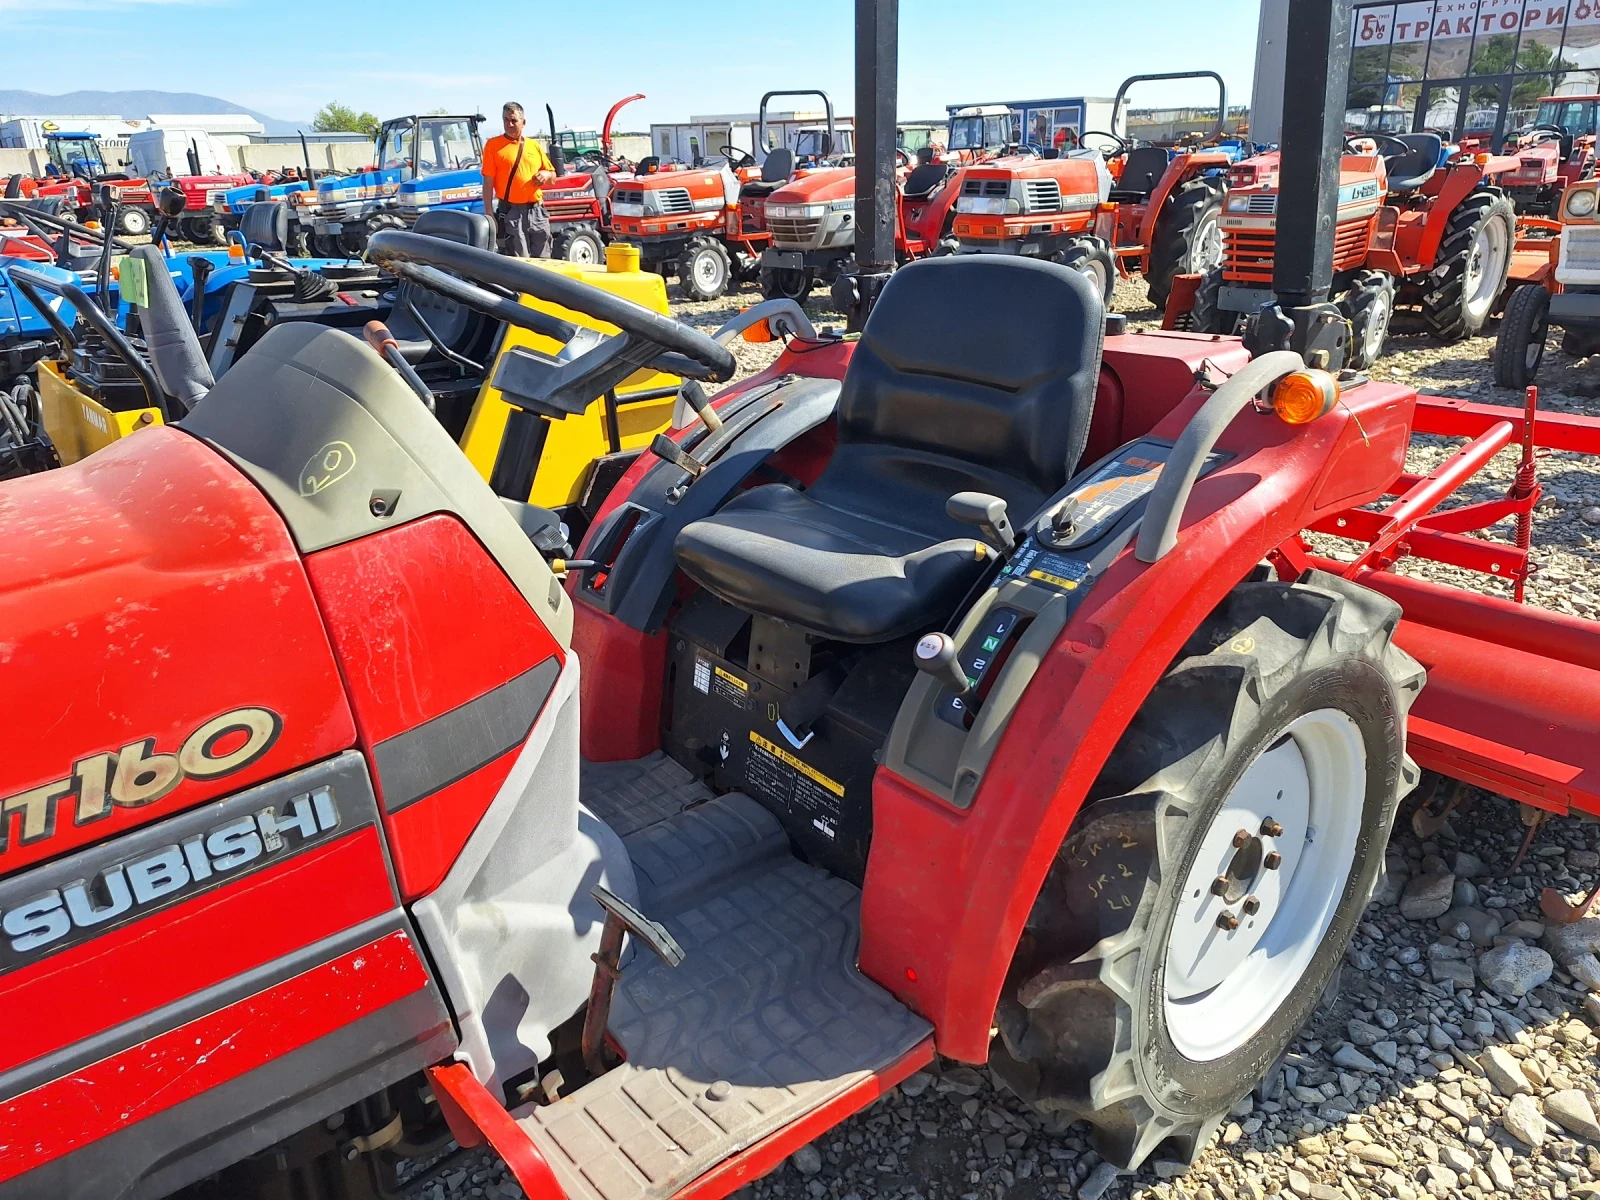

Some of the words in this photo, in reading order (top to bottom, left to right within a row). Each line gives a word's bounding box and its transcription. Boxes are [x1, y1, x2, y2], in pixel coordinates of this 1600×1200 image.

[1396, 6, 1565, 40] ТРАКТОРИ
[984, 638, 998, 649] N
[973, 658, 986, 670] 2
[952, 697, 962, 709] 3
[0, 706, 283, 853] T160
[0, 785, 341, 953] SUBISHI
